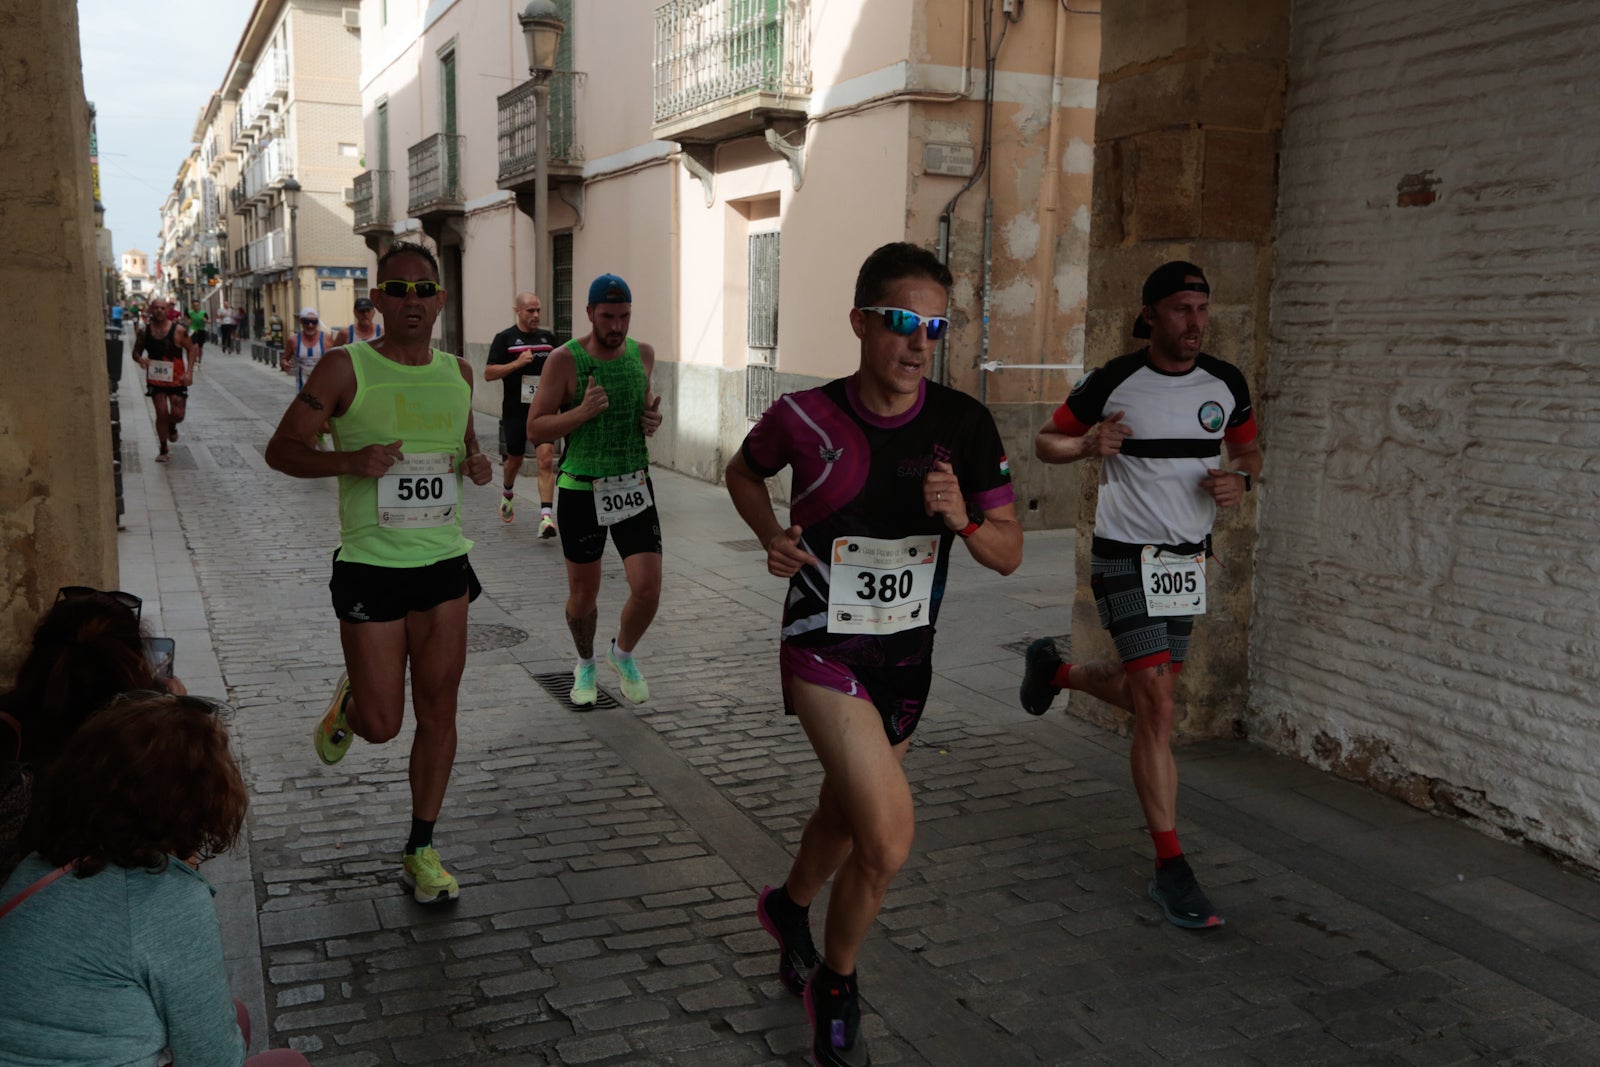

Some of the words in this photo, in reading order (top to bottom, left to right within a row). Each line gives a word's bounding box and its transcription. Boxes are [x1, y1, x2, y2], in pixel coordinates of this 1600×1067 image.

[397, 477, 443, 501] 560
[602, 491, 645, 512] 3048
[856, 569, 913, 603] 380
[1150, 571, 1197, 594] 3005
